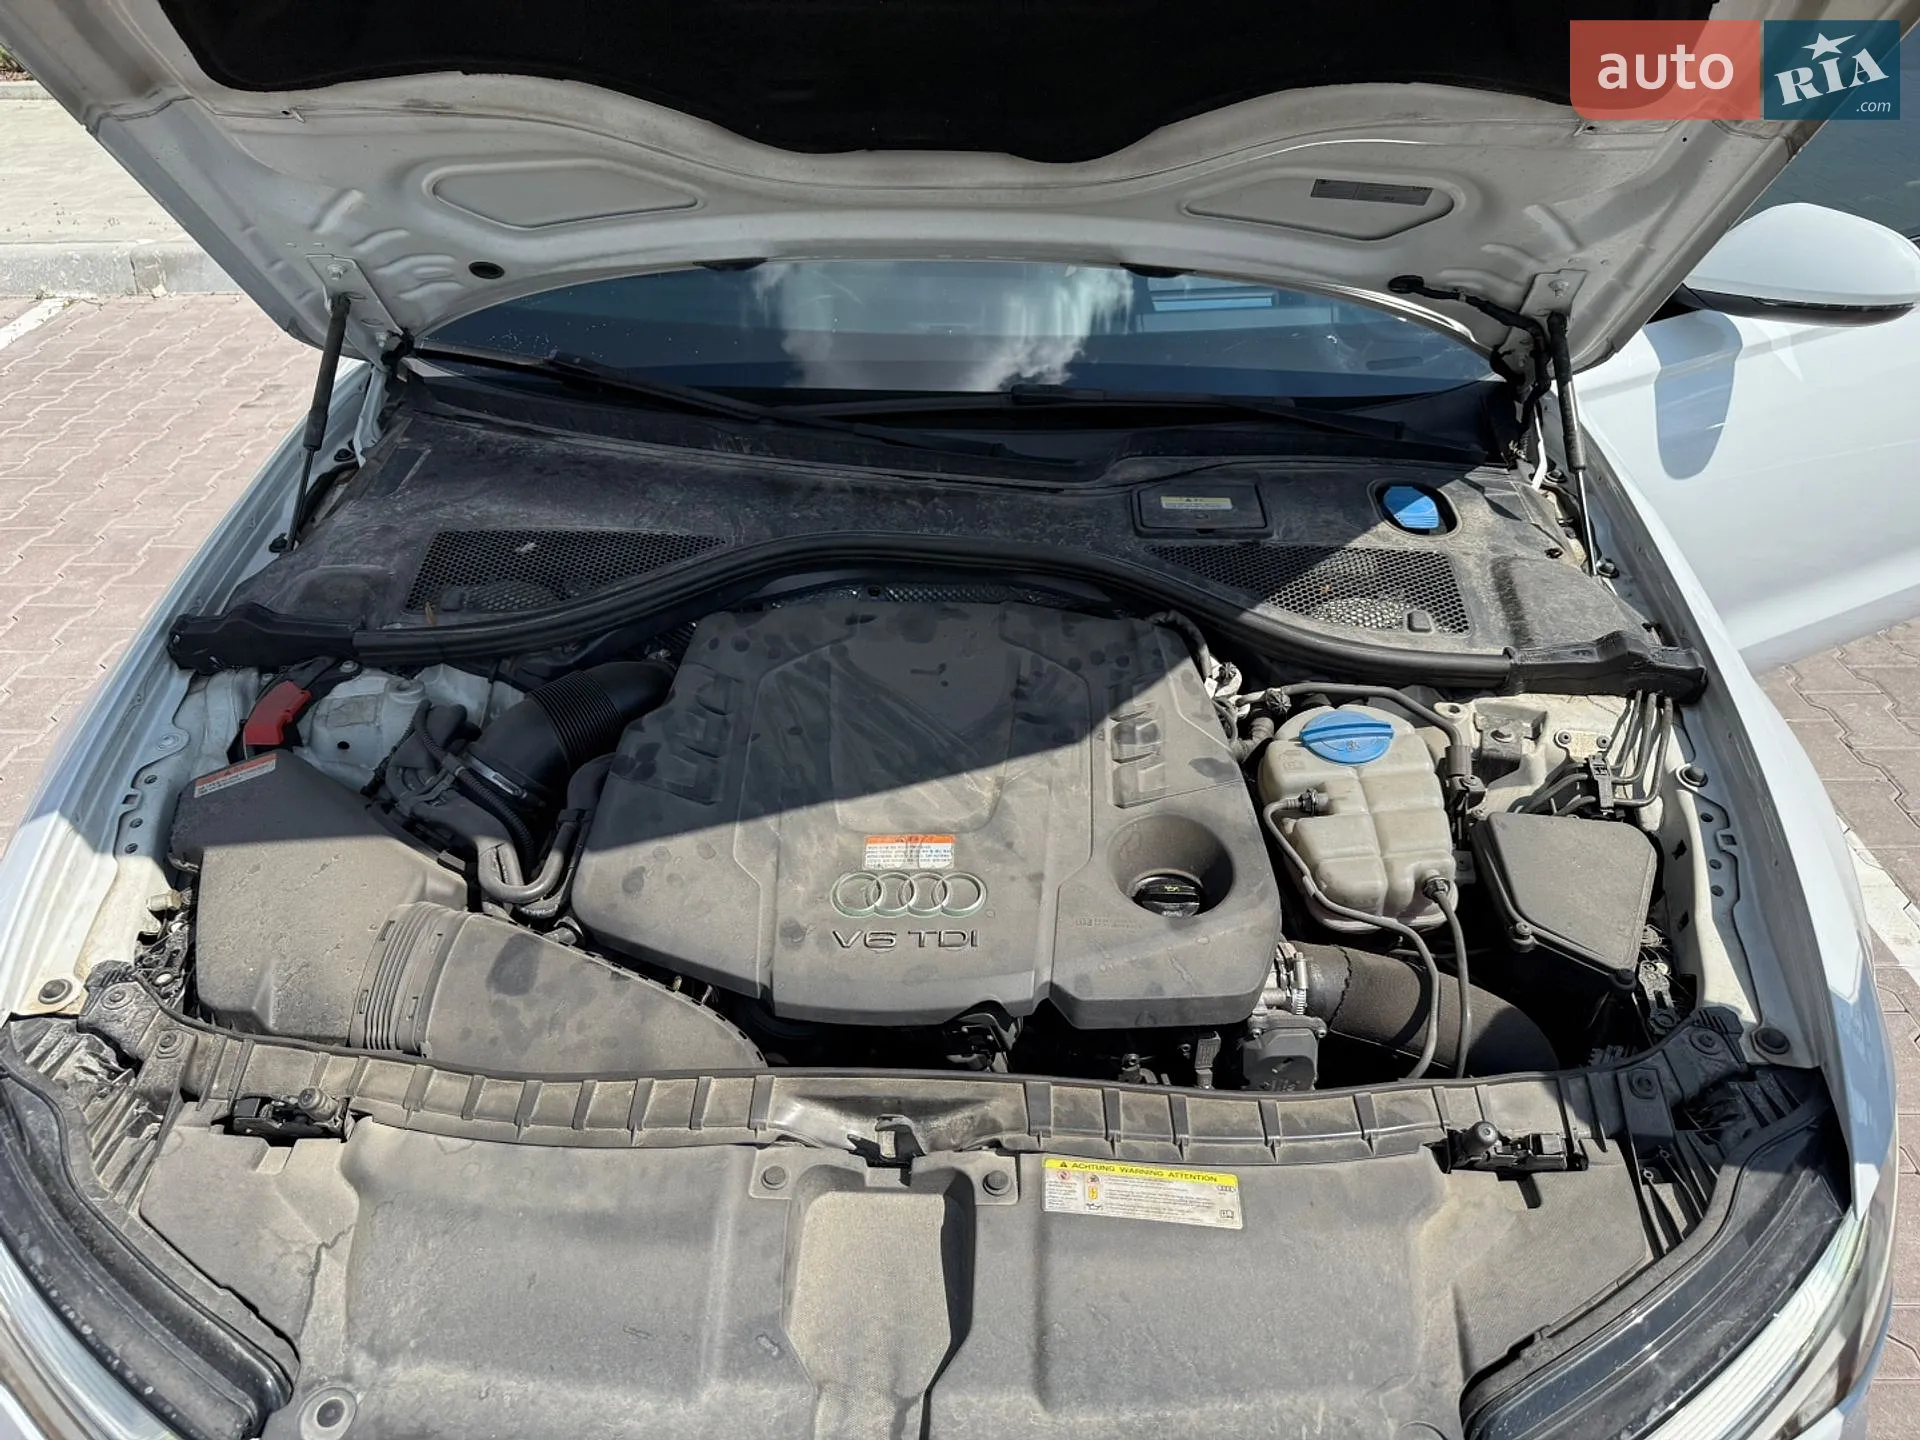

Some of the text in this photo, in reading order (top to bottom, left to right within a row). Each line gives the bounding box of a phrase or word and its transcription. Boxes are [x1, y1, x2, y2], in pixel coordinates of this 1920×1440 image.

[832, 929, 979, 949] V6 TDI
[1071, 1162, 1218, 1183] ACHTUNG WARNING ATTENTION
